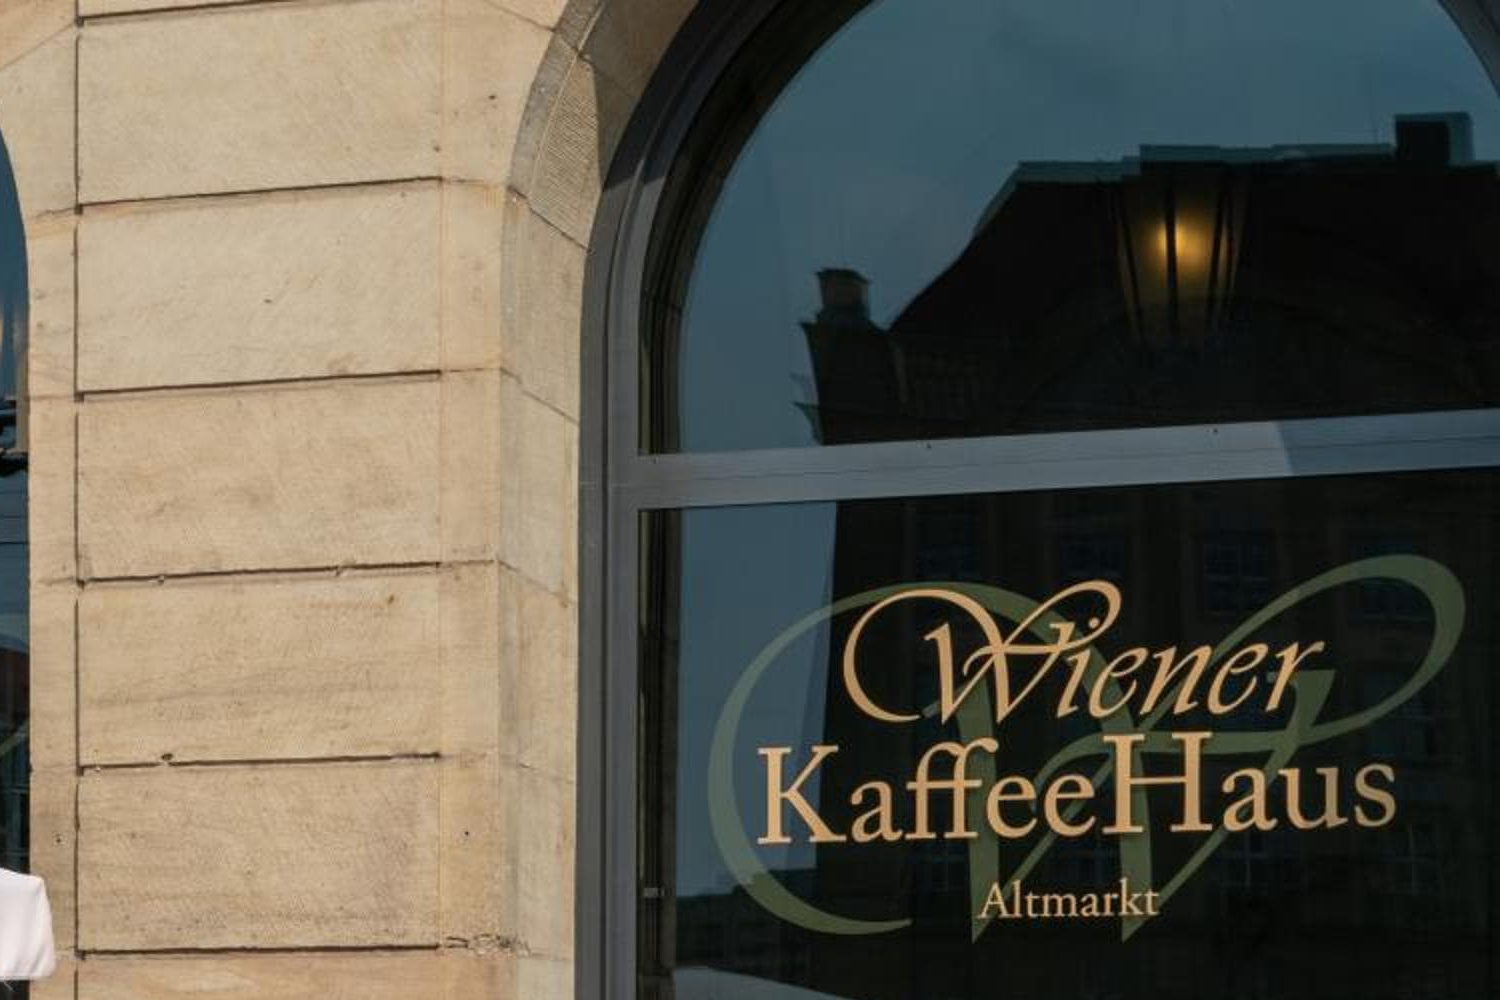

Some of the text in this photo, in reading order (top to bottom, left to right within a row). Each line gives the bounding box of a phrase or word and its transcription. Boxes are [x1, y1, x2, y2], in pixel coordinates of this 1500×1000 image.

[843, 580, 1325, 725] Wiener
[756, 731, 1397, 845] KaffeeHaus
[978, 878, 1160, 920] Altmarkt
